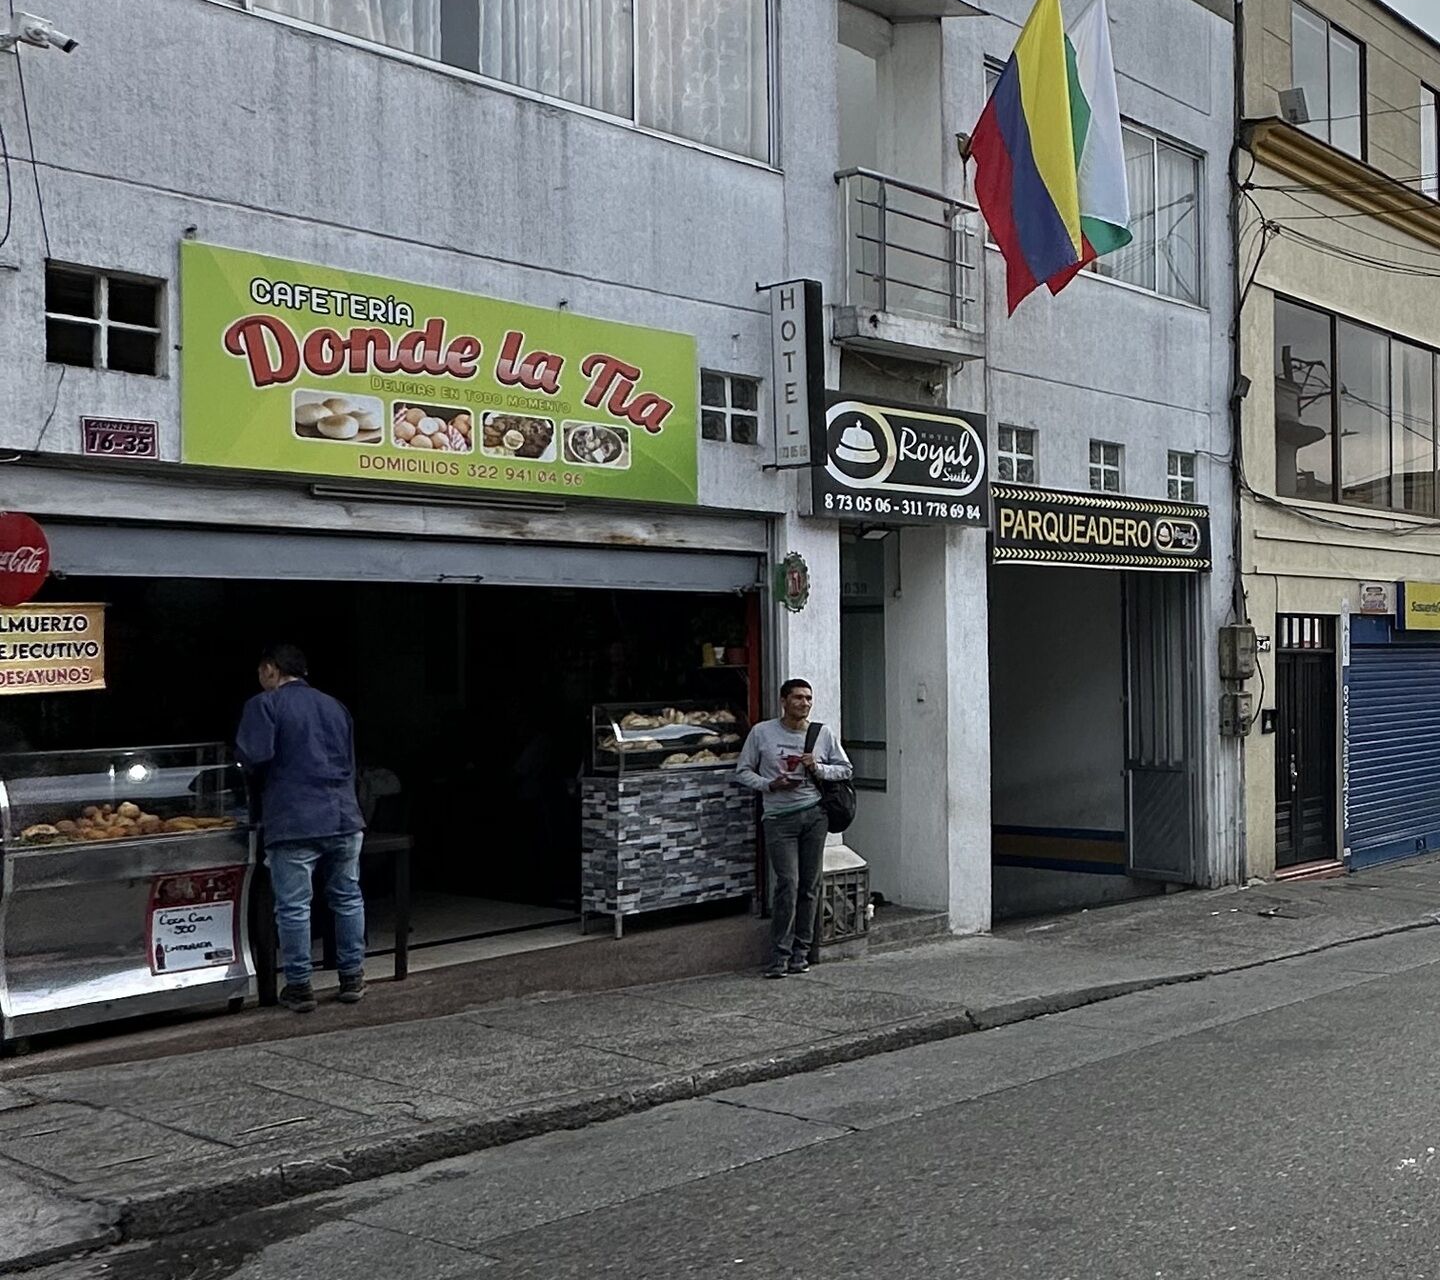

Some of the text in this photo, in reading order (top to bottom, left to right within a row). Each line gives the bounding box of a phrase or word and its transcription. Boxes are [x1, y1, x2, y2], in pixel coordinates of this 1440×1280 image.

[250, 277, 414, 328] CAFETERÍA
[223, 313, 482, 388] Donde
[496, 330, 565, 395] la
[780, 288, 799, 436] HOTEL
[371, 376, 572, 414] DELICIAS EN TODO MOMENTO
[88, 432, 153, 455] 16-35
[899, 426, 973, 479] Royal
[359, 454, 583, 486] DOMICILIOS 322 941 04 96
[942, 468, 973, 484] Suite
[825, 493, 834, 509] 8
[836, 494, 853, 511] 73
[856, 495, 872, 512] 05
[875, 498, 891, 513] 06
[902, 499, 923, 516] 311
[926, 502, 948, 518] 778
[950, 504, 965, 519] 69
[967, 505, 981, 520] 84
[1000, 507, 1151, 549] PARQUEADERO
[0, 616, 88, 633] LMUERZO
[0, 641, 99, 660] EJECUTIVO
